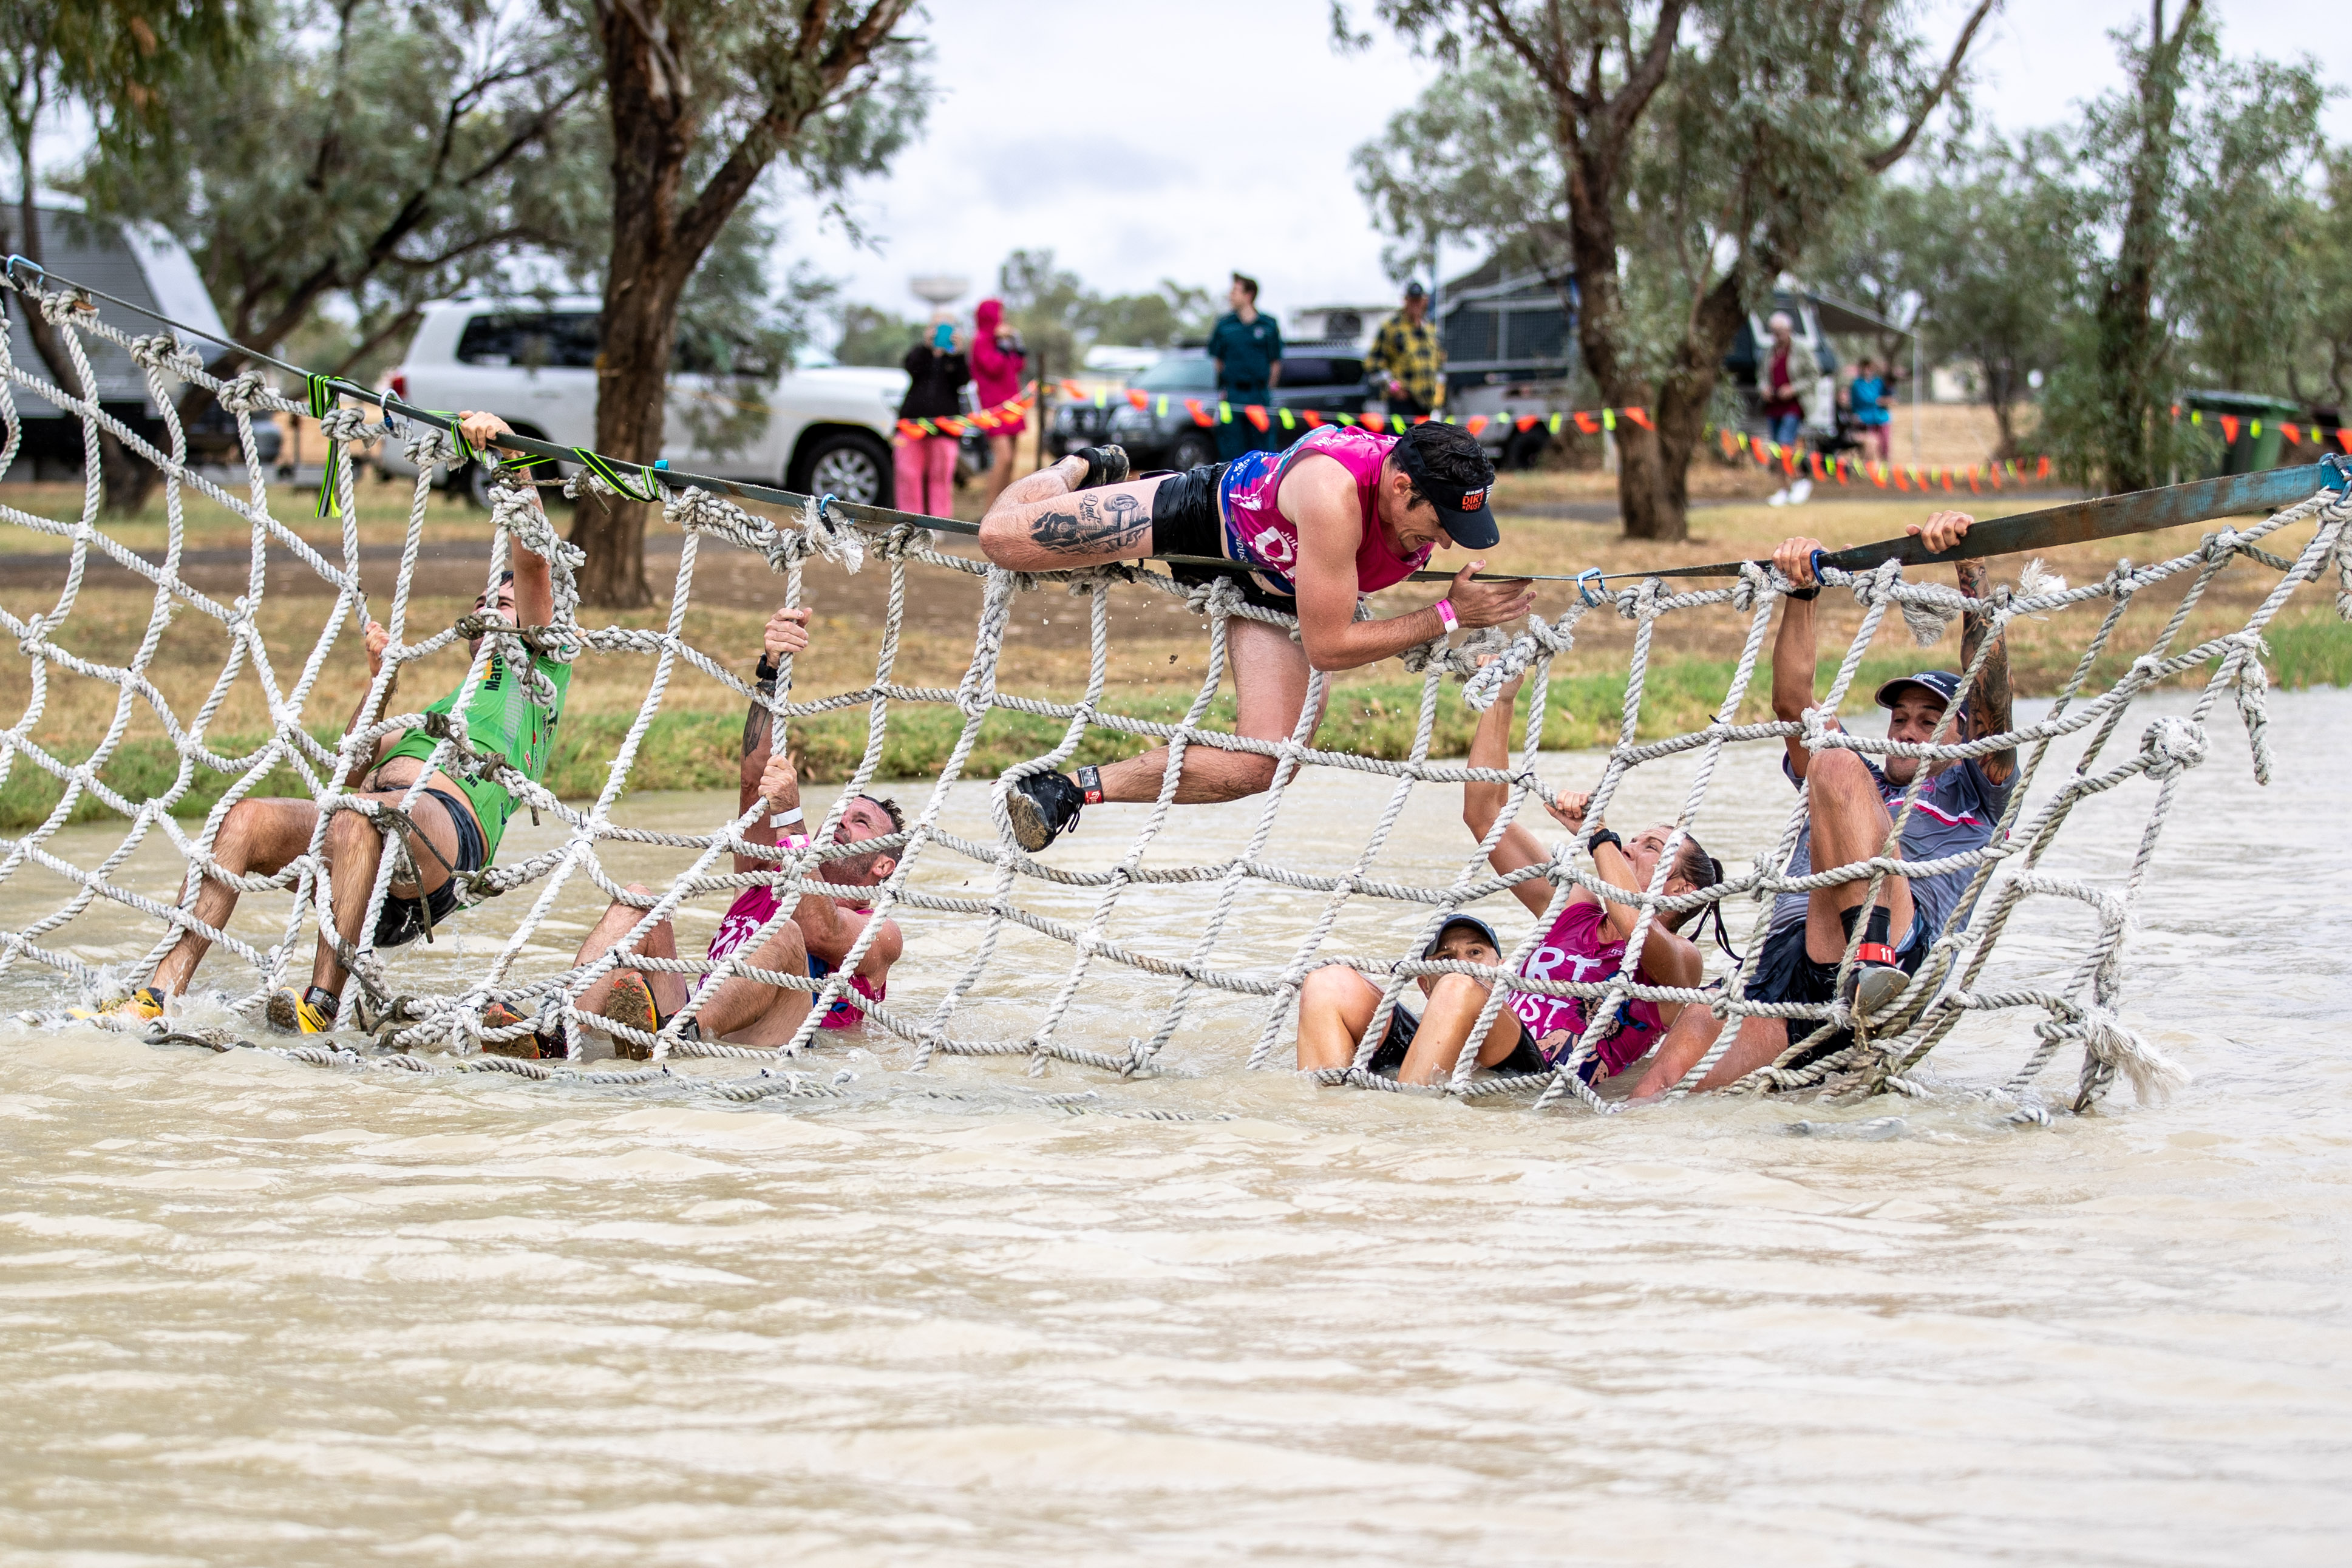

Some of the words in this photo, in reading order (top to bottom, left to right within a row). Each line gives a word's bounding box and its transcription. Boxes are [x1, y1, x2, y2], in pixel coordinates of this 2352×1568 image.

[1083, 494, 1101, 521] Dad
[1462, 492, 1484, 505] DIRT
[1466, 502, 1482, 511] DUST
[1516, 946, 1603, 982] RT
[1880, 947, 1892, 962] 11
[1505, 990, 1570, 1028] UST
